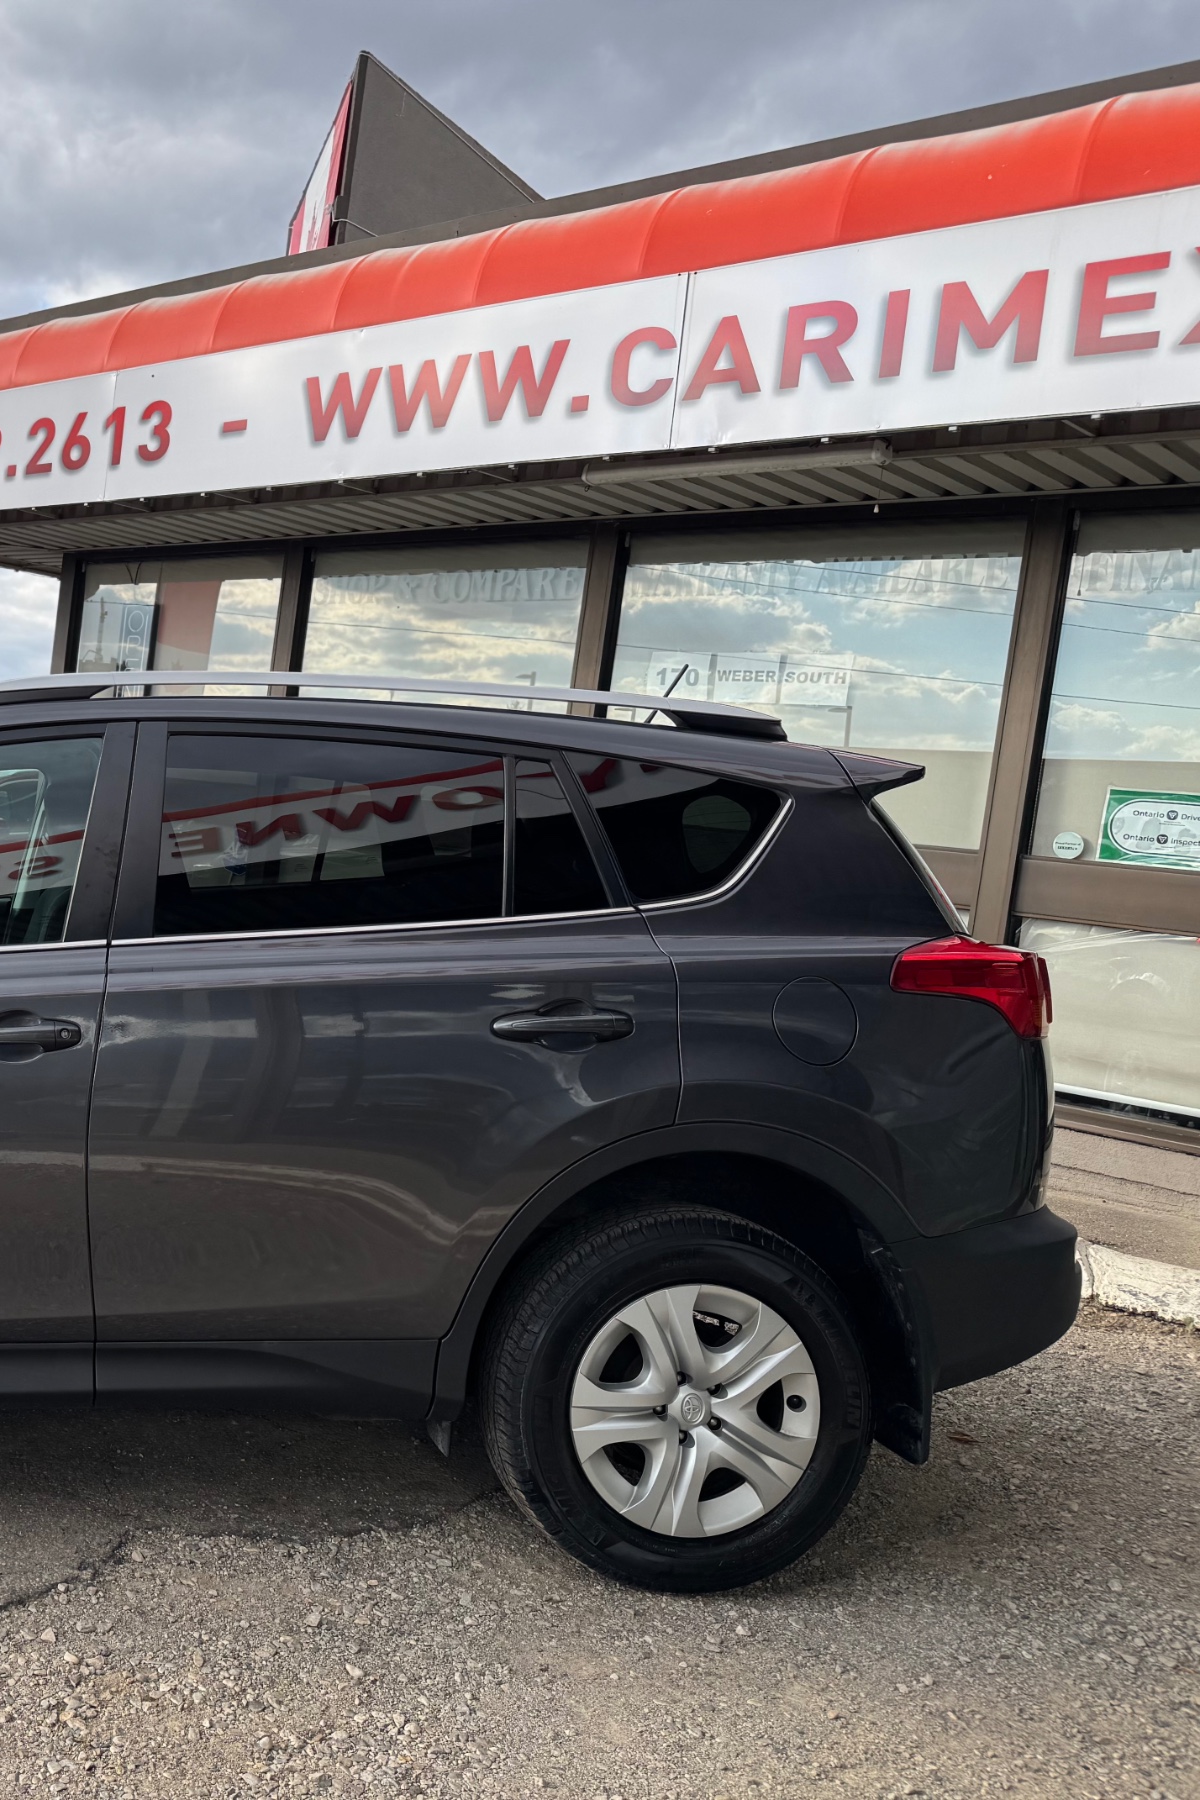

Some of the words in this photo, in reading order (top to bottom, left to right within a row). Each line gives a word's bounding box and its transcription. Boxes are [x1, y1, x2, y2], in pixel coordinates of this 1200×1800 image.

[304, 246, 1200, 443] WWW.CARIME
[431, 567, 581, 604] COMPARE
[717, 670, 776, 683] WEBER
[784, 672, 847, 684] SOUTH
[1133, 810, 1165, 819] Ontario
[1123, 833, 1155, 843] Ontario
